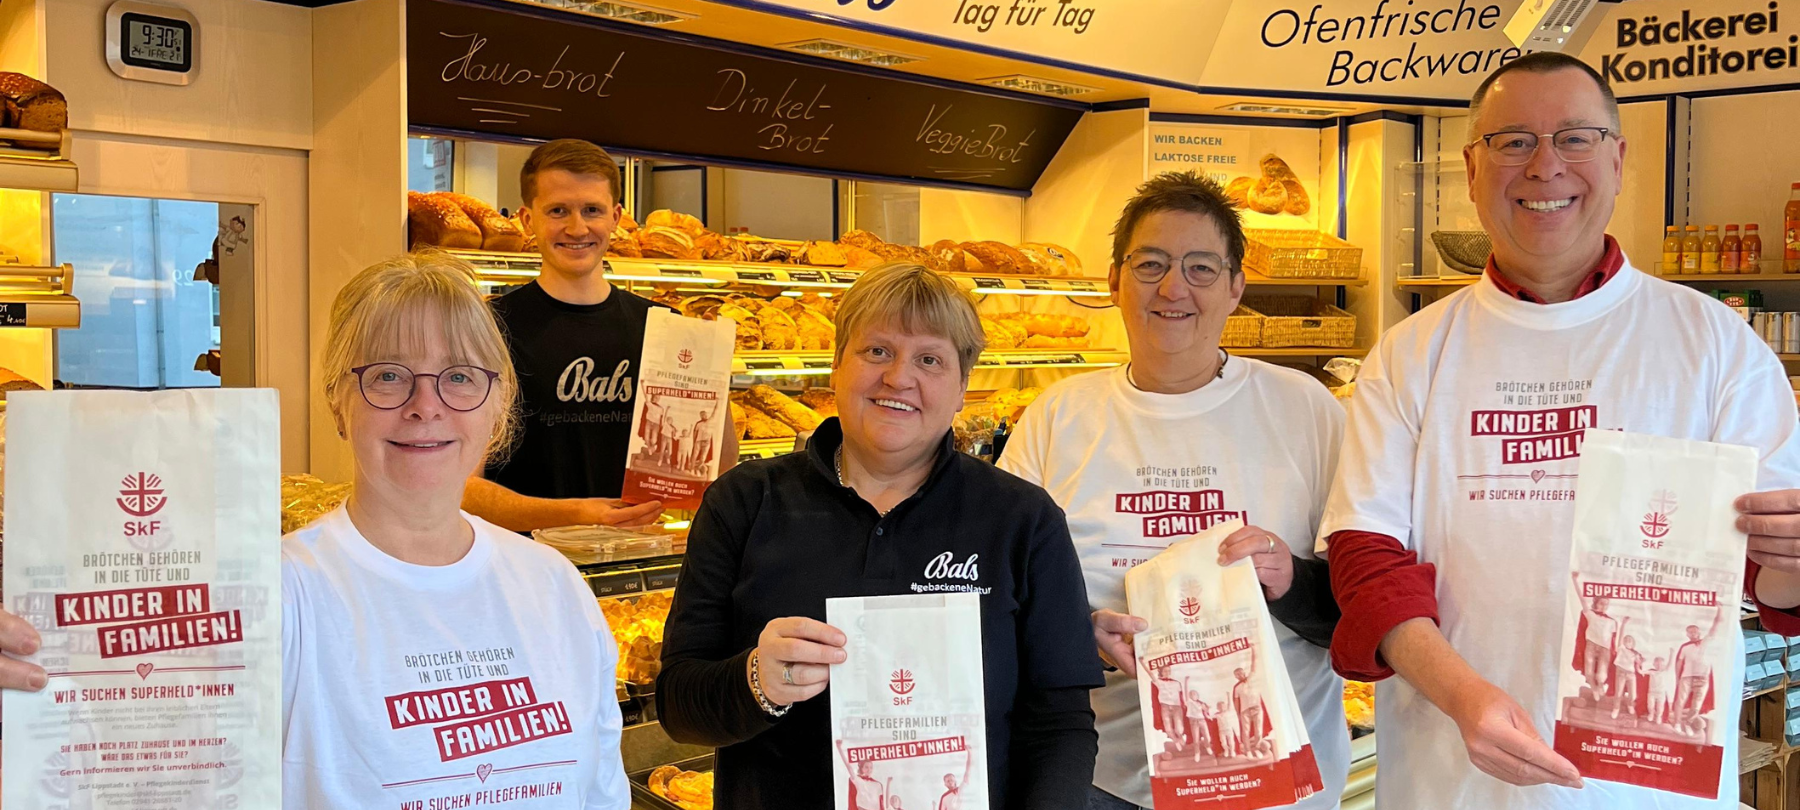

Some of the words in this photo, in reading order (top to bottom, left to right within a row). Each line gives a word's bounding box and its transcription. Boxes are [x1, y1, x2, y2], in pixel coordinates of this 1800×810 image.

[953, 0, 1000, 32] Tag
[1005, 0, 1047, 26] für
[1053, 0, 1095, 34] Tag
[1261, 0, 1500, 48] Ofenfrische
[1617, 1, 1778, 48] Bäckerei
[142, 25, 174, 48] 9:30
[1326, 43, 1532, 86] Backware
[1602, 35, 1798, 83] Konditorei
[706, 68, 831, 121] Dinkel-
[757, 123, 834, 154] Brot
[1154, 135, 1176, 144] WIR
[1178, 136, 1223, 146] BACKEN
[1154, 153, 1204, 163] LAKTOSE
[1206, 155, 1237, 164] FREIE
[556, 356, 633, 403] Bals
[656, 371, 708, 385] PFLEGEFAMILIEN
[674, 381, 690, 389] SIND
[1496, 381, 1545, 392] BRÖTCHEN
[1549, 379, 1592, 392] GEHÖREN
[1503, 395, 1514, 405] IN
[1518, 395, 1533, 405] DIE
[1537, 393, 1558, 405] TÜTE
[1563, 393, 1582, 404] UND
[1476, 411, 1558, 433] KINDER
[1569, 408, 1591, 429] IN
[1507, 434, 1583, 462] FAMILI
[1136, 466, 1177, 477] BRÖTCHEN
[1180, 465, 1218, 477] GEHÖREN
[1143, 477, 1151, 487] IN
[1154, 477, 1167, 487] DIE
[1171, 477, 1190, 488] TÜTE
[1193, 477, 1210, 487] UND
[1120, 493, 1191, 512] KINDER
[1200, 492, 1219, 510] IN
[1468, 490, 1485, 500] WIR
[1488, 489, 1526, 501] SUCHEN
[1529, 490, 1575, 501] PFLEGEFA
[123, 520, 161, 536] SkF
[1641, 539, 1664, 549] SkF
[83, 551, 143, 568] BRÖTCHEN
[149, 549, 201, 565] GEHÖREN
[924, 551, 979, 581] Bals
[1111, 558, 1127, 567] WIR
[1602, 555, 1700, 579] PFLEGEFAMILIEN
[94, 571, 106, 584] IN
[111, 569, 130, 583] DIE
[135, 567, 162, 583] TÜTE
[167, 567, 190, 581] UND
[1635, 571, 1663, 586] SIND
[910, 581, 992, 594] #gebackeneNatur
[62, 591, 163, 622] KINDER
[176, 588, 203, 613] IN
[1183, 617, 1200, 625] SkF
[104, 610, 237, 655] FAMILIEN!
[1159, 624, 1231, 645] PFLEGEFAMILIEN
[1185, 640, 1207, 649] SIND
[404, 650, 463, 668] BRÖTCHEN
[466, 647, 515, 663] GEHÖREN
[418, 671, 431, 684] IN
[435, 668, 452, 681] DIE
[456, 663, 483, 679] TÜTE
[487, 663, 509, 677] UND
[54, 689, 76, 703] WIR
[82, 687, 126, 702] SUCHEN
[393, 687, 493, 724] KINDER
[502, 682, 531, 706] IN
[893, 696, 913, 706] SkF
[440, 701, 568, 757] FAMILIEN!
[861, 716, 947, 729] PFLEGEFAMILIEN
[892, 729, 917, 741] SIND
[60, 744, 71, 753] SIE
[74, 743, 96, 751] HABEN
[99, 742, 117, 750] NOCH
[118, 741, 138, 750] PLATZ
[141, 740, 170, 749] ZUHAUSE
[173, 739, 186, 748] UND
[188, 739, 197, 747] IM
[198, 737, 227, 747] HERZEN?
[1611, 739, 1644, 750] WOLLEN
[1646, 743, 1670, 754] AUCH
[101, 753, 119, 761] WÄRE
[121, 752, 134, 761] DAS
[136, 752, 158, 760] ETWAS
[159, 751, 172, 760] FÜR
[174, 750, 189, 759] SIE?
[60, 769, 81, 777] Gern
[166, 761, 227, 771] unverbindlich.
[1200, 776, 1228, 785] WOLLEN
[1229, 774, 1249, 782] AUCH
[401, 800, 424, 810] WIR
[429, 793, 471, 810] SUCHEN
[475, 781, 562, 805] PFLEGEFAMILIEN
